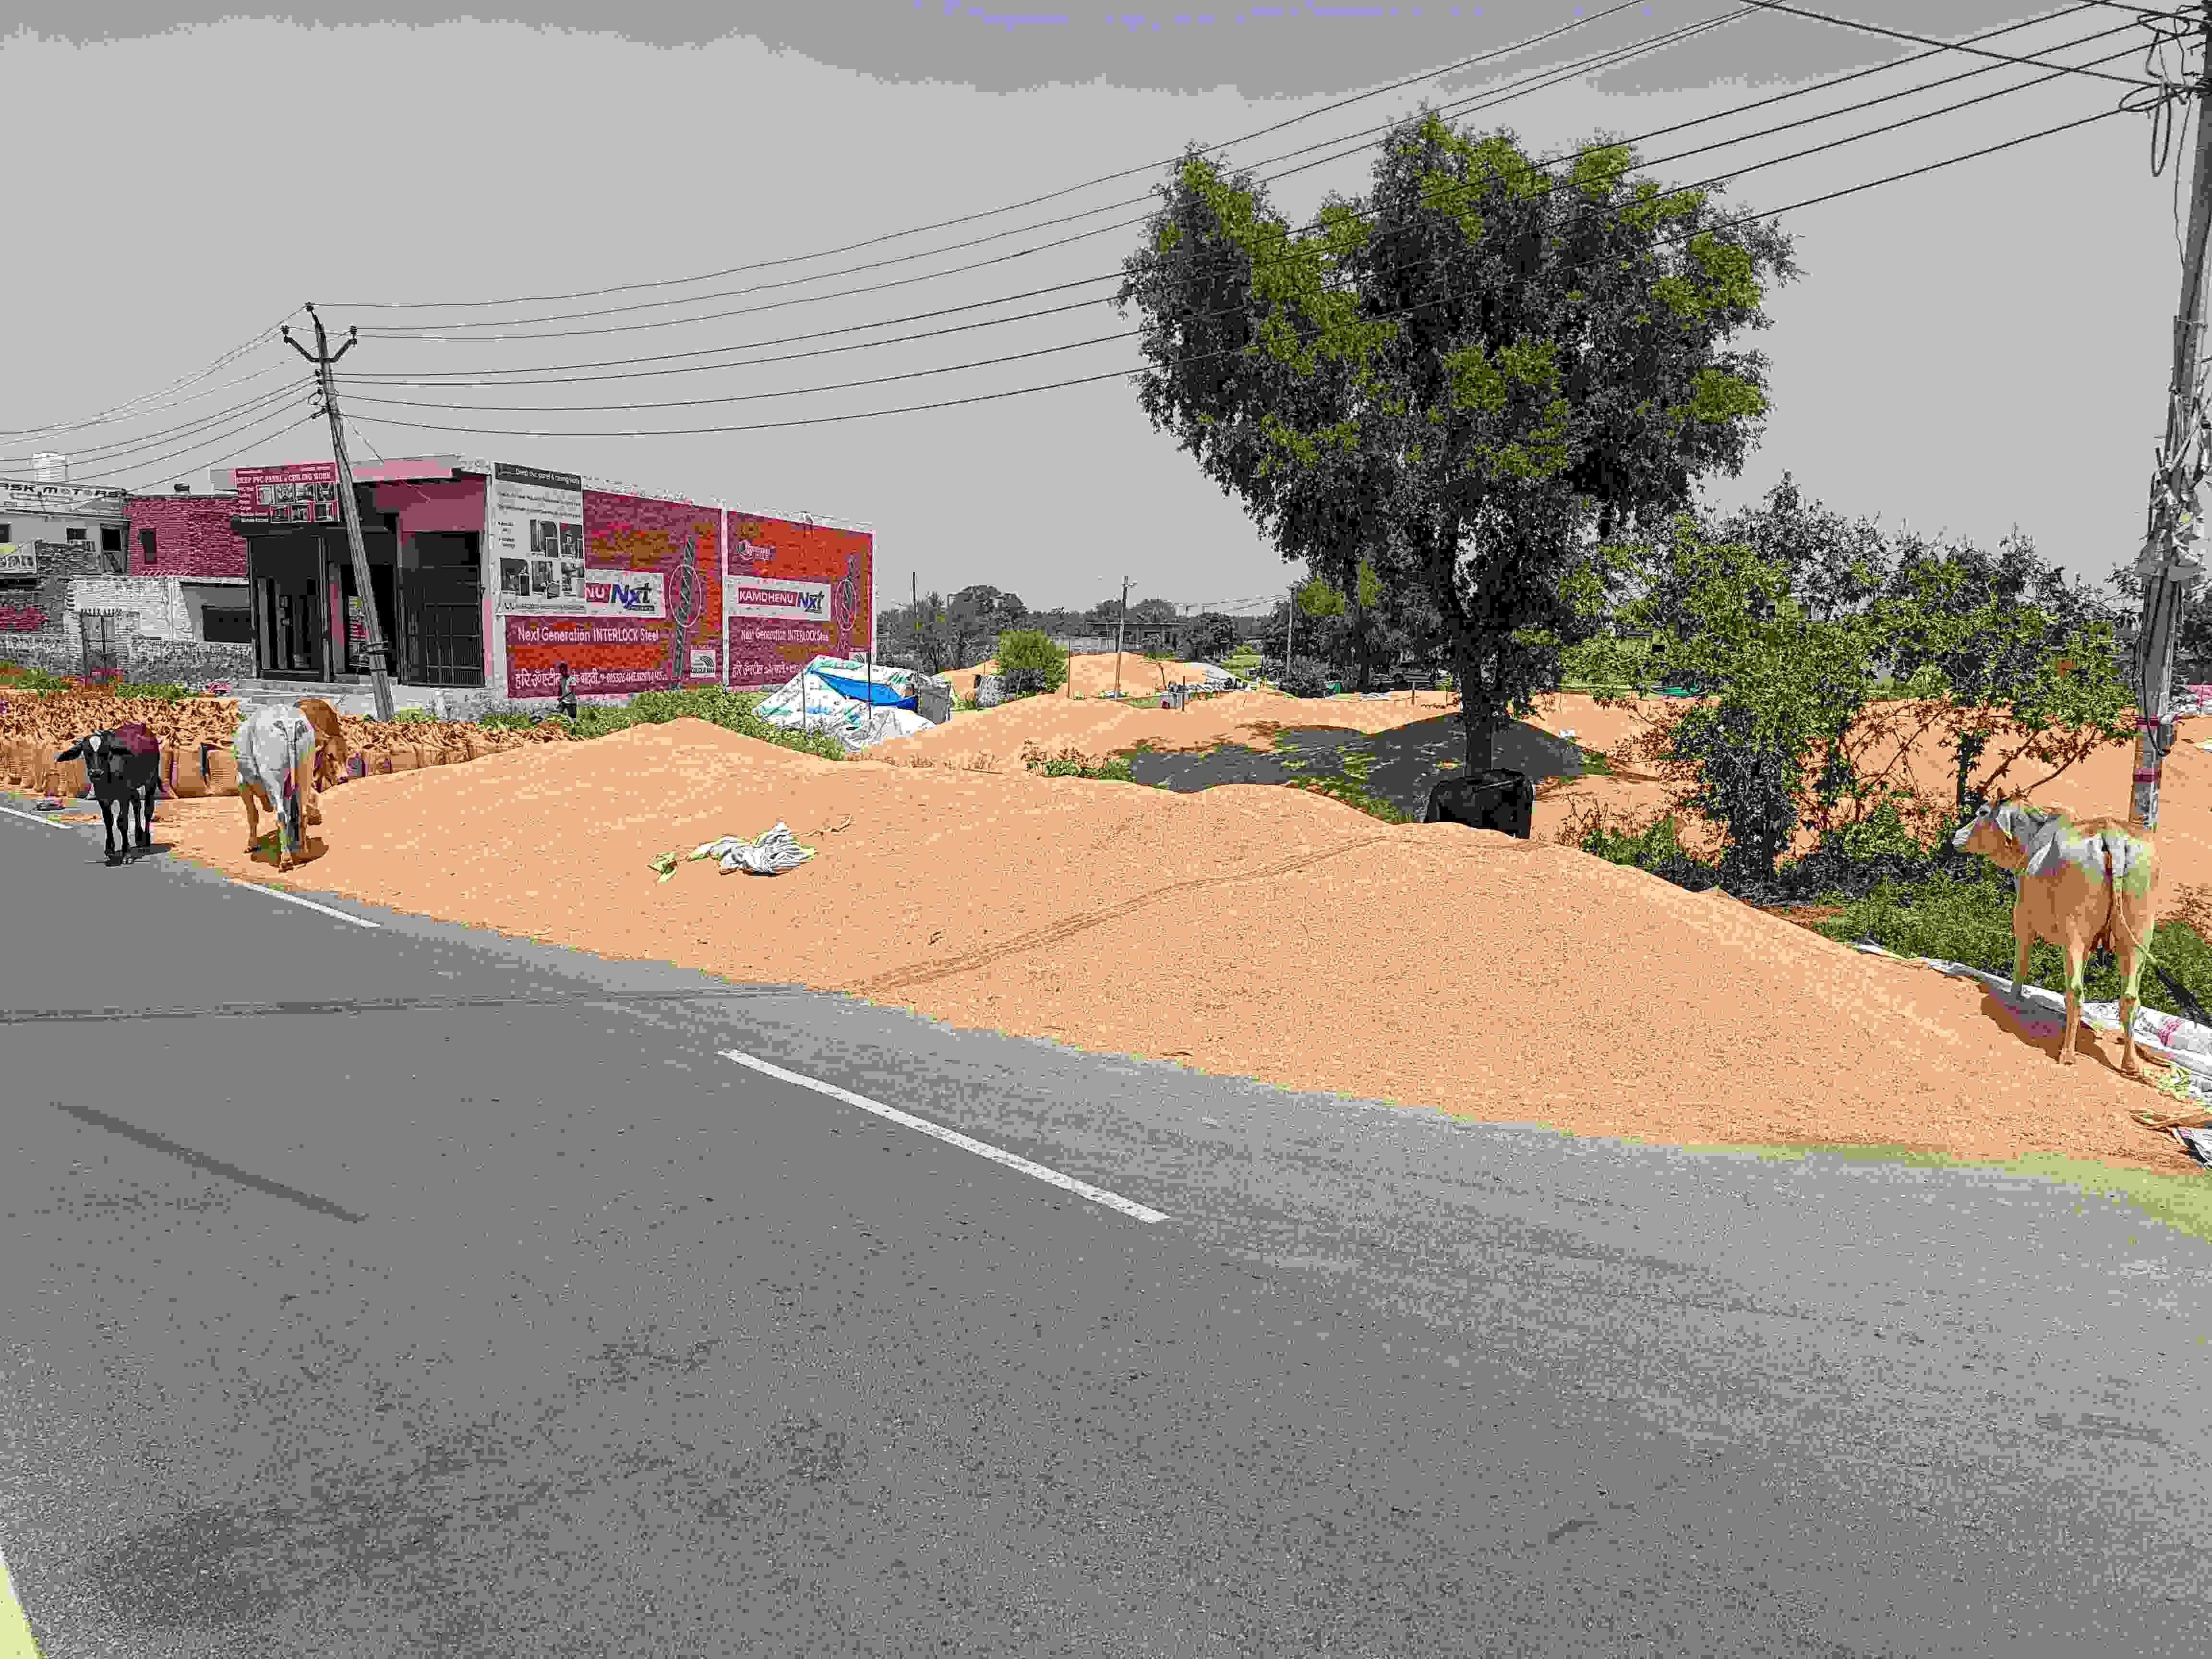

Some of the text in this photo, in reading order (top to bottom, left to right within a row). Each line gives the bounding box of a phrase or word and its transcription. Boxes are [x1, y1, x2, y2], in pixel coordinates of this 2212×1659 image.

[313, 472, 331, 480] WORK
[739, 590, 793, 604] KAMDHENU
[517, 626, 659, 642] Next Generation INTERLOCK Steel
[755, 627, 786, 641] Generation
